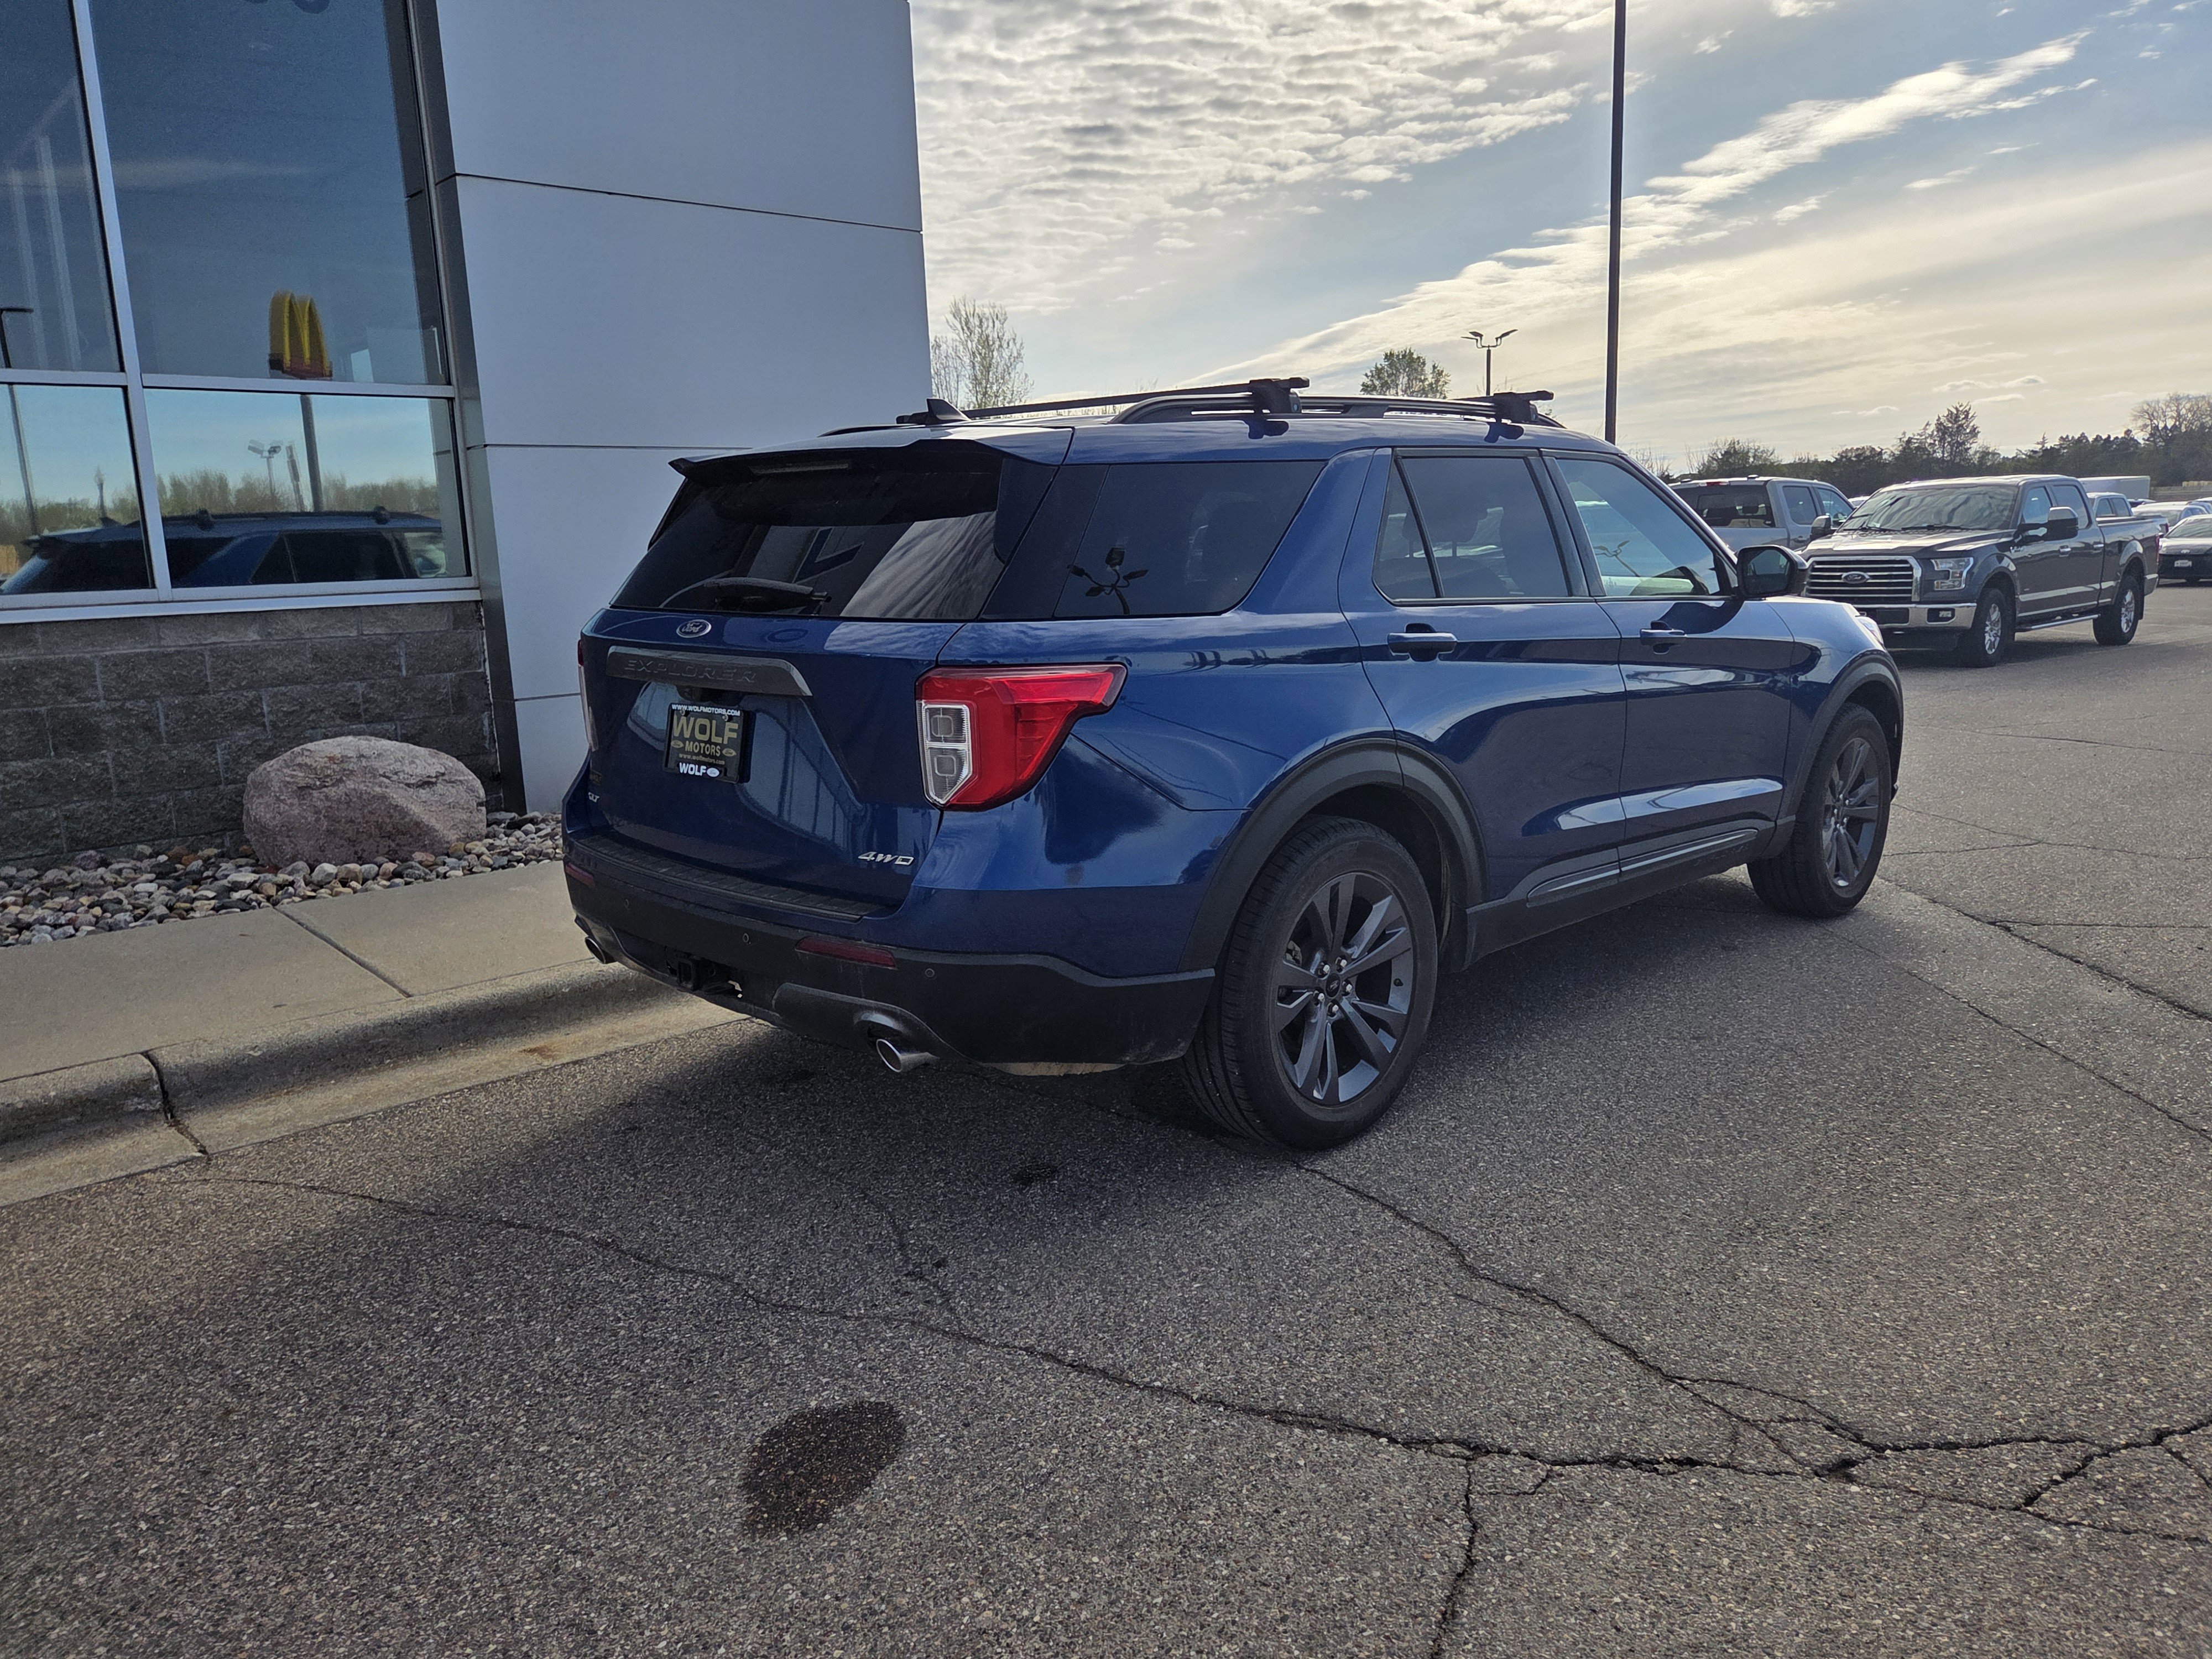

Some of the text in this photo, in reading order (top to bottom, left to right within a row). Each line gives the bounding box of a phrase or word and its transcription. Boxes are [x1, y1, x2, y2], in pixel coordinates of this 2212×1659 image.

[624, 659, 757, 684] EXPLORER
[671, 704, 740, 716] WWW.WOLFMOTORS.COM
[672, 714, 739, 744] WOLF
[685, 740, 721, 757] MOTORS
[679, 762, 707, 776] WOLF
[858, 851, 914, 865] 4WD
